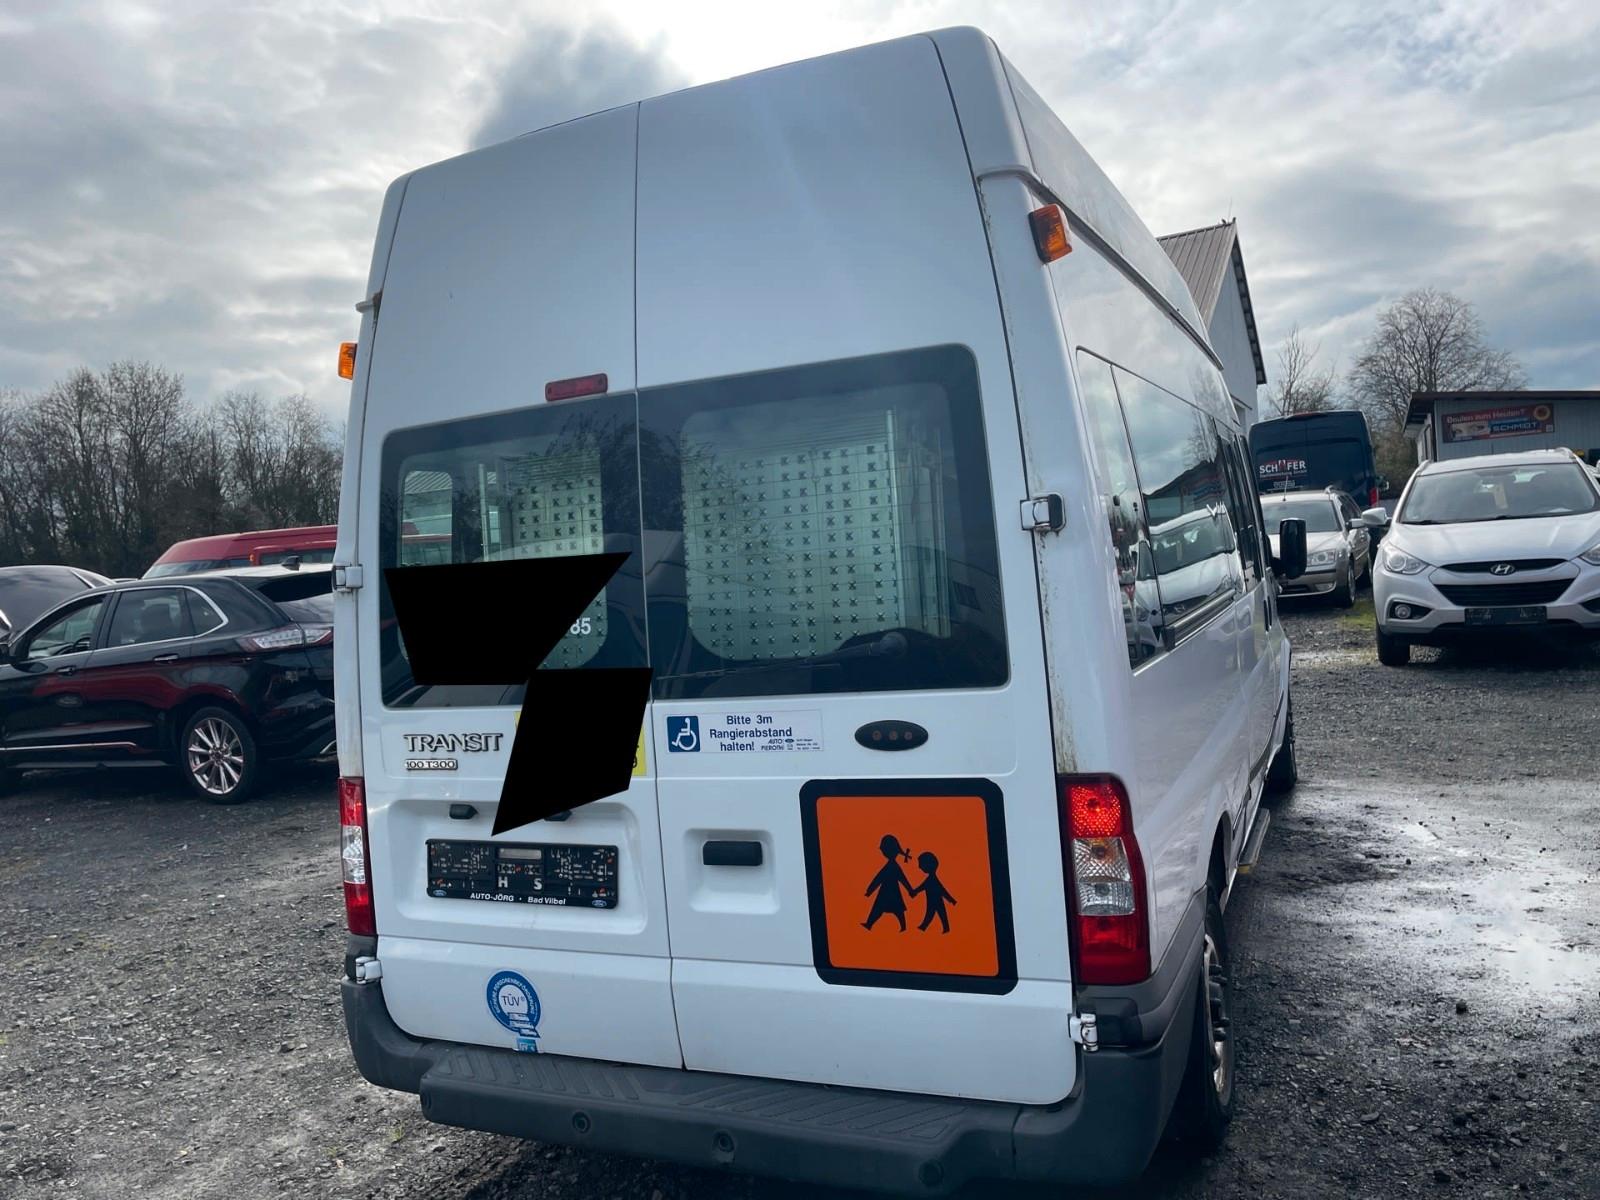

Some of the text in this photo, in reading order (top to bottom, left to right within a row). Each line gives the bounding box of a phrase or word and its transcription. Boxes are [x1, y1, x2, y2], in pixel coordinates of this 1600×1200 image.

[726, 714, 773, 725] Bitte 3m
[709, 727, 793, 741] Rangierabstand
[403, 733, 504, 752] TRANSIT
[720, 742, 755, 752] halten!
[426, 761, 455, 769] T300
[470, 892, 514, 902] AUTO-JÖRG
[544, 897, 566, 905] Vilbel
[501, 993, 520, 1007] TÜV
